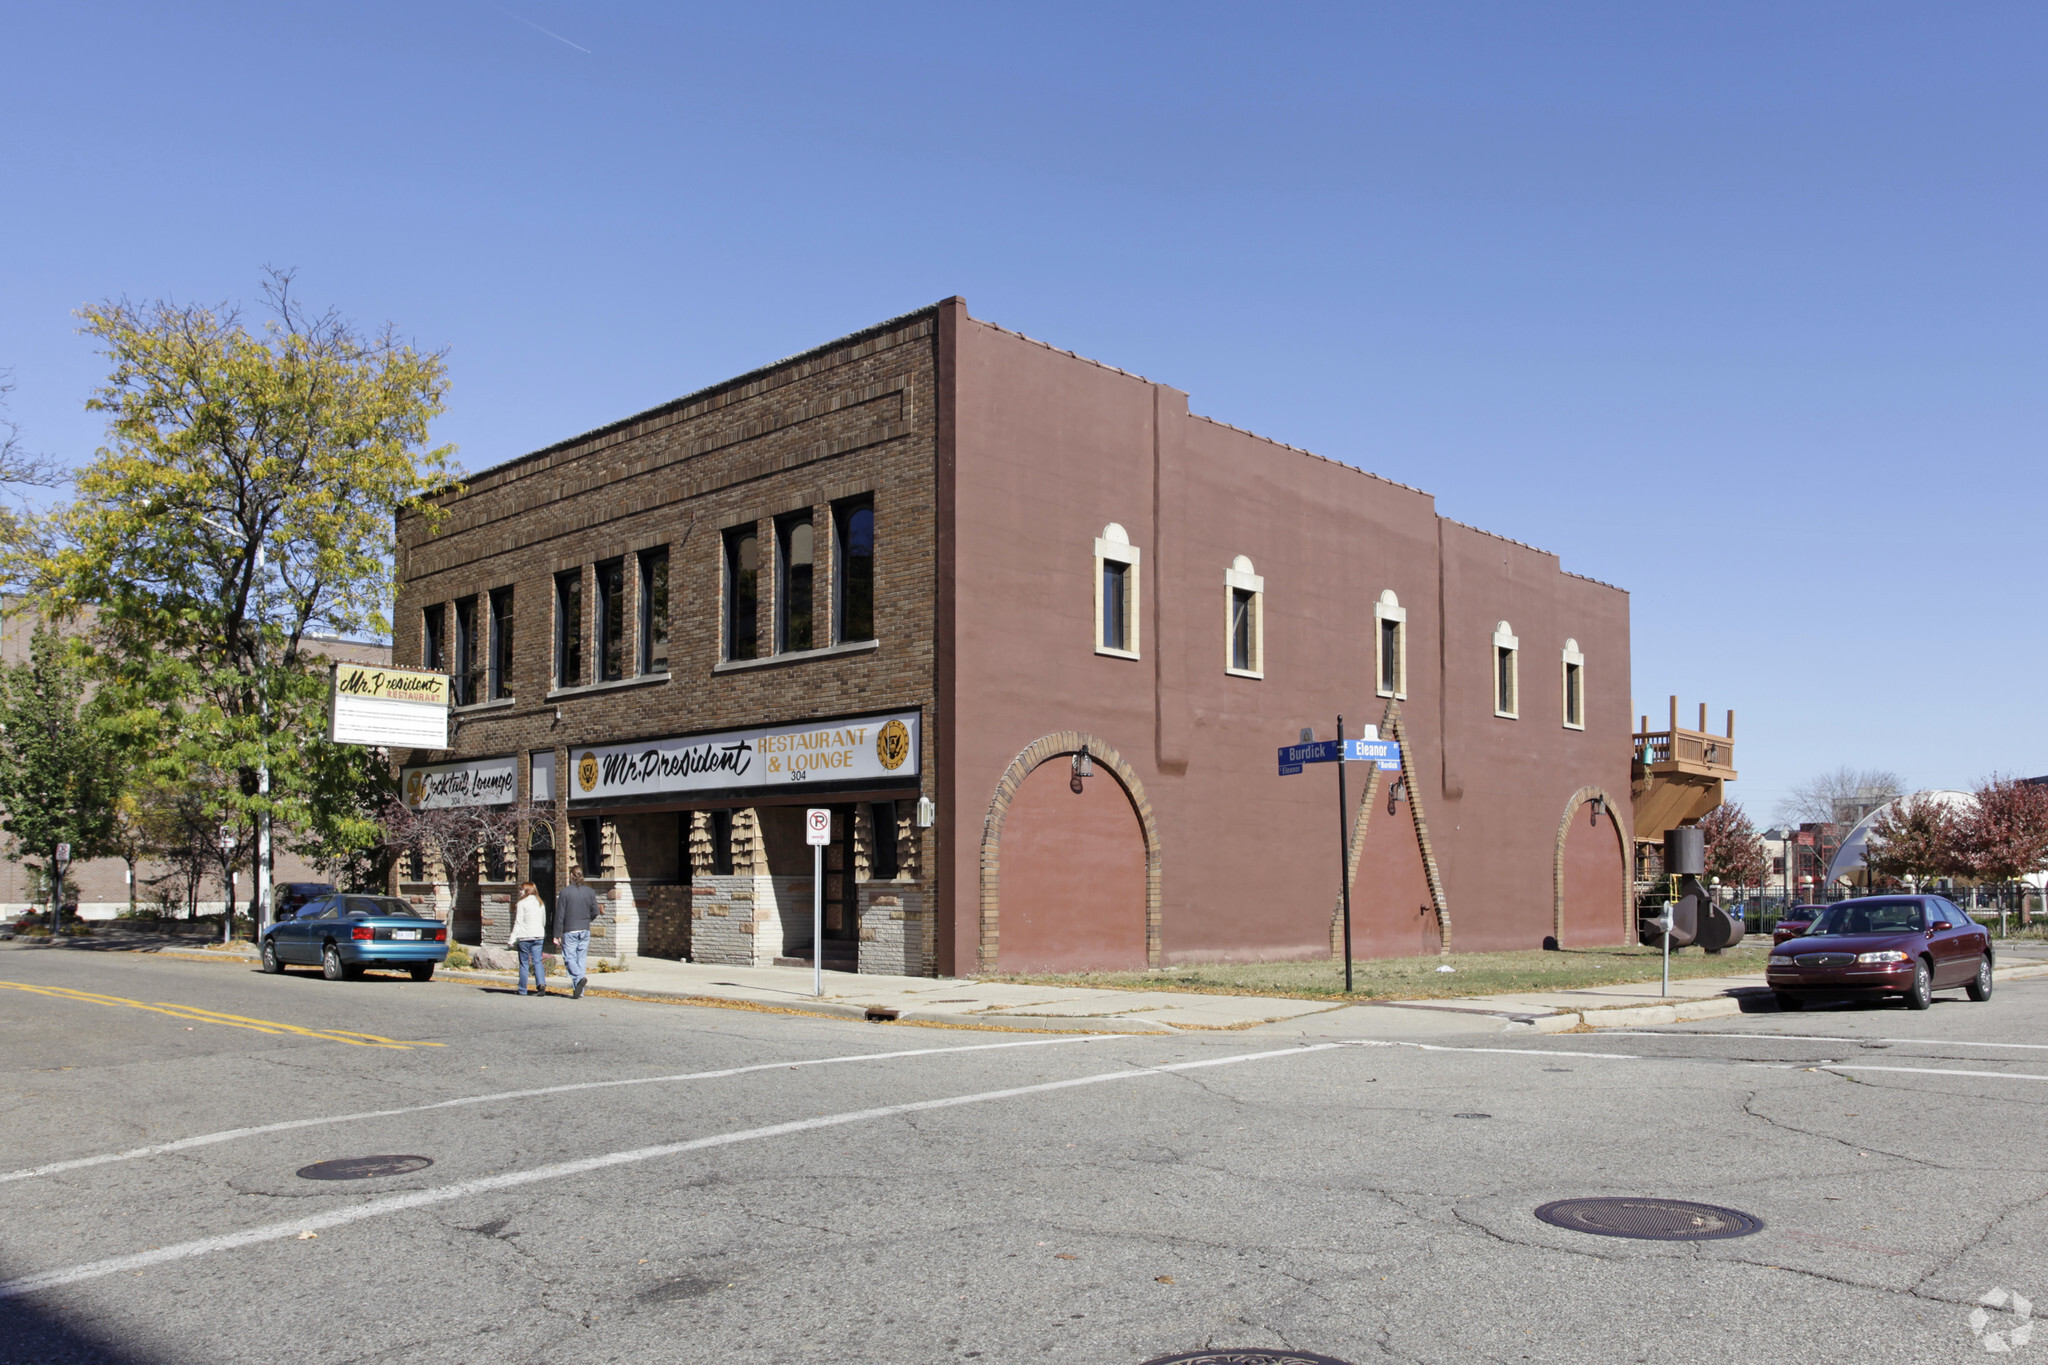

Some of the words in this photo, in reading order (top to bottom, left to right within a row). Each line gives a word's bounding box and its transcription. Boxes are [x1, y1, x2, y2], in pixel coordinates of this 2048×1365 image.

[341, 671, 371, 694] Mr.
[372, 672, 443, 695] President
[386, 690, 441, 702] RESTAURANT
[757, 727, 868, 755] RESTAURANT
[1356, 742, 1387, 757] Eleanor
[603, 753, 640, 786] Mr.
[640, 739, 752, 784] President
[768, 756, 782, 773] &
[787, 750, 854, 772] LOUNGE
[1289, 744, 1325, 761] Burdick
[473, 768, 513, 798] Lounge
[790, 770, 807, 782] 304
[450, 796, 461, 806] 304
